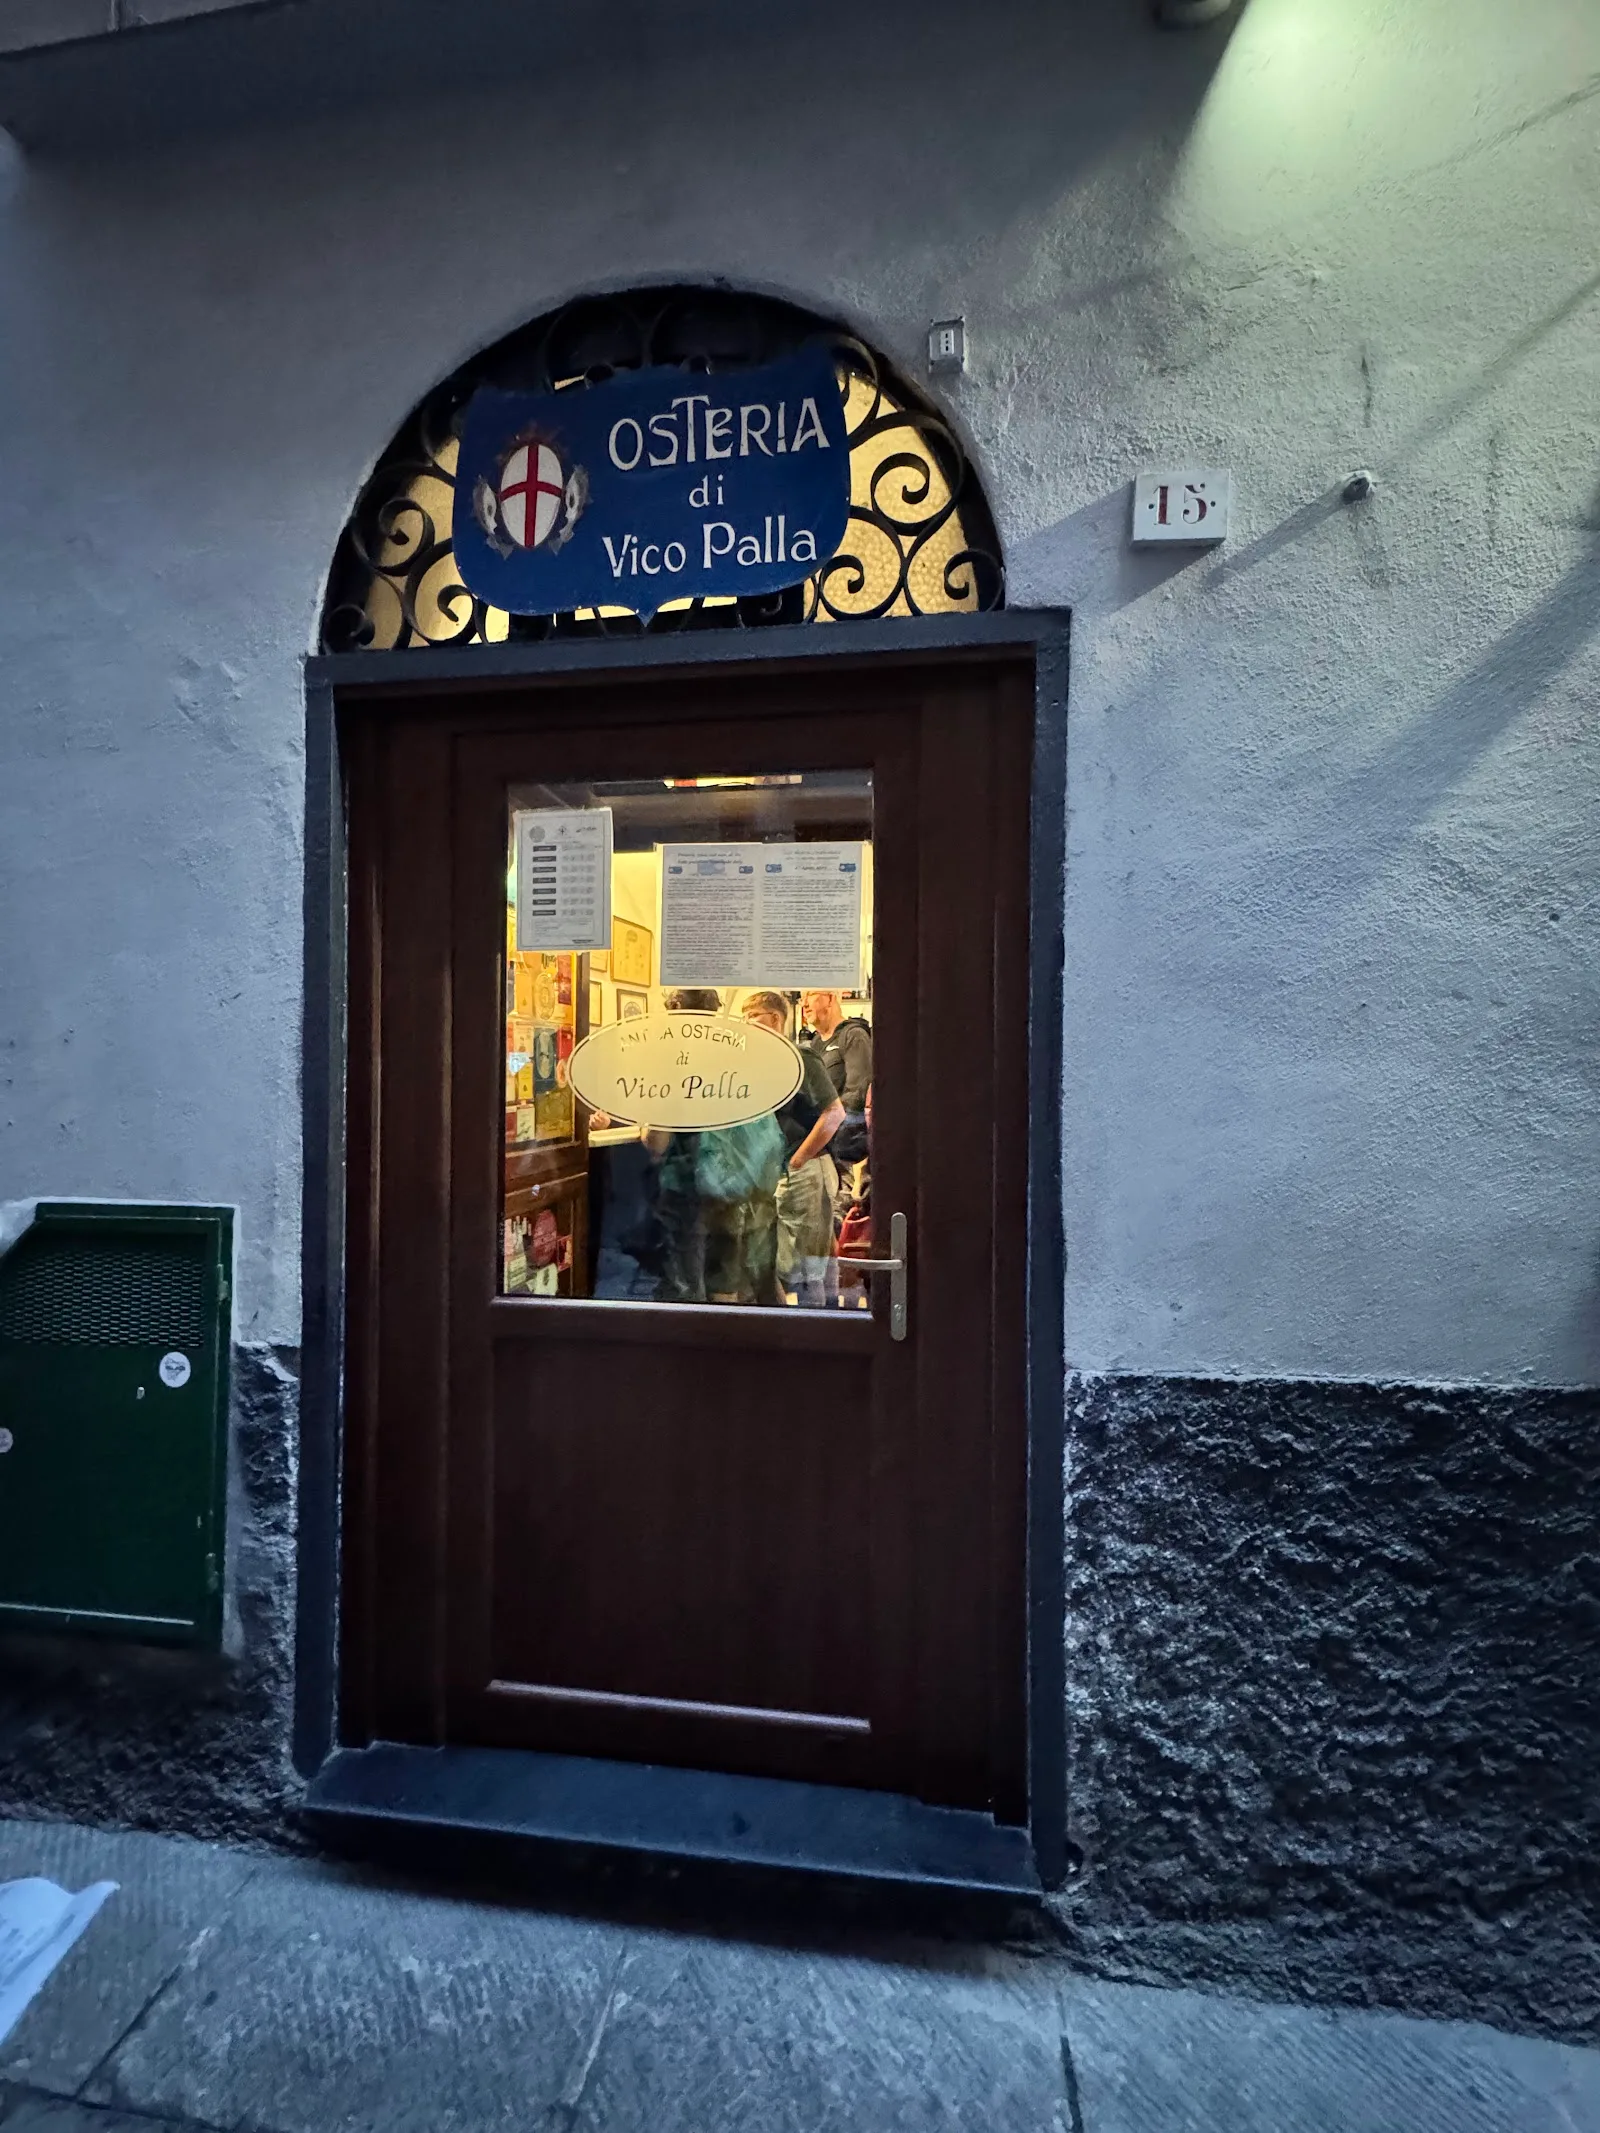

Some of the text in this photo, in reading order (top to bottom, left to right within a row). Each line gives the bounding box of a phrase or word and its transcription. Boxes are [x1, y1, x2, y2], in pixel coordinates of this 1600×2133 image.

[608, 395, 830, 471] OSTERIA
[688, 474, 724, 508] di
[1153, 482, 1208, 525] 15
[602, 515, 817, 578] Vico Palla
[676, 1050, 690, 1065] di
[616, 1071, 752, 1099] Vico Palla
